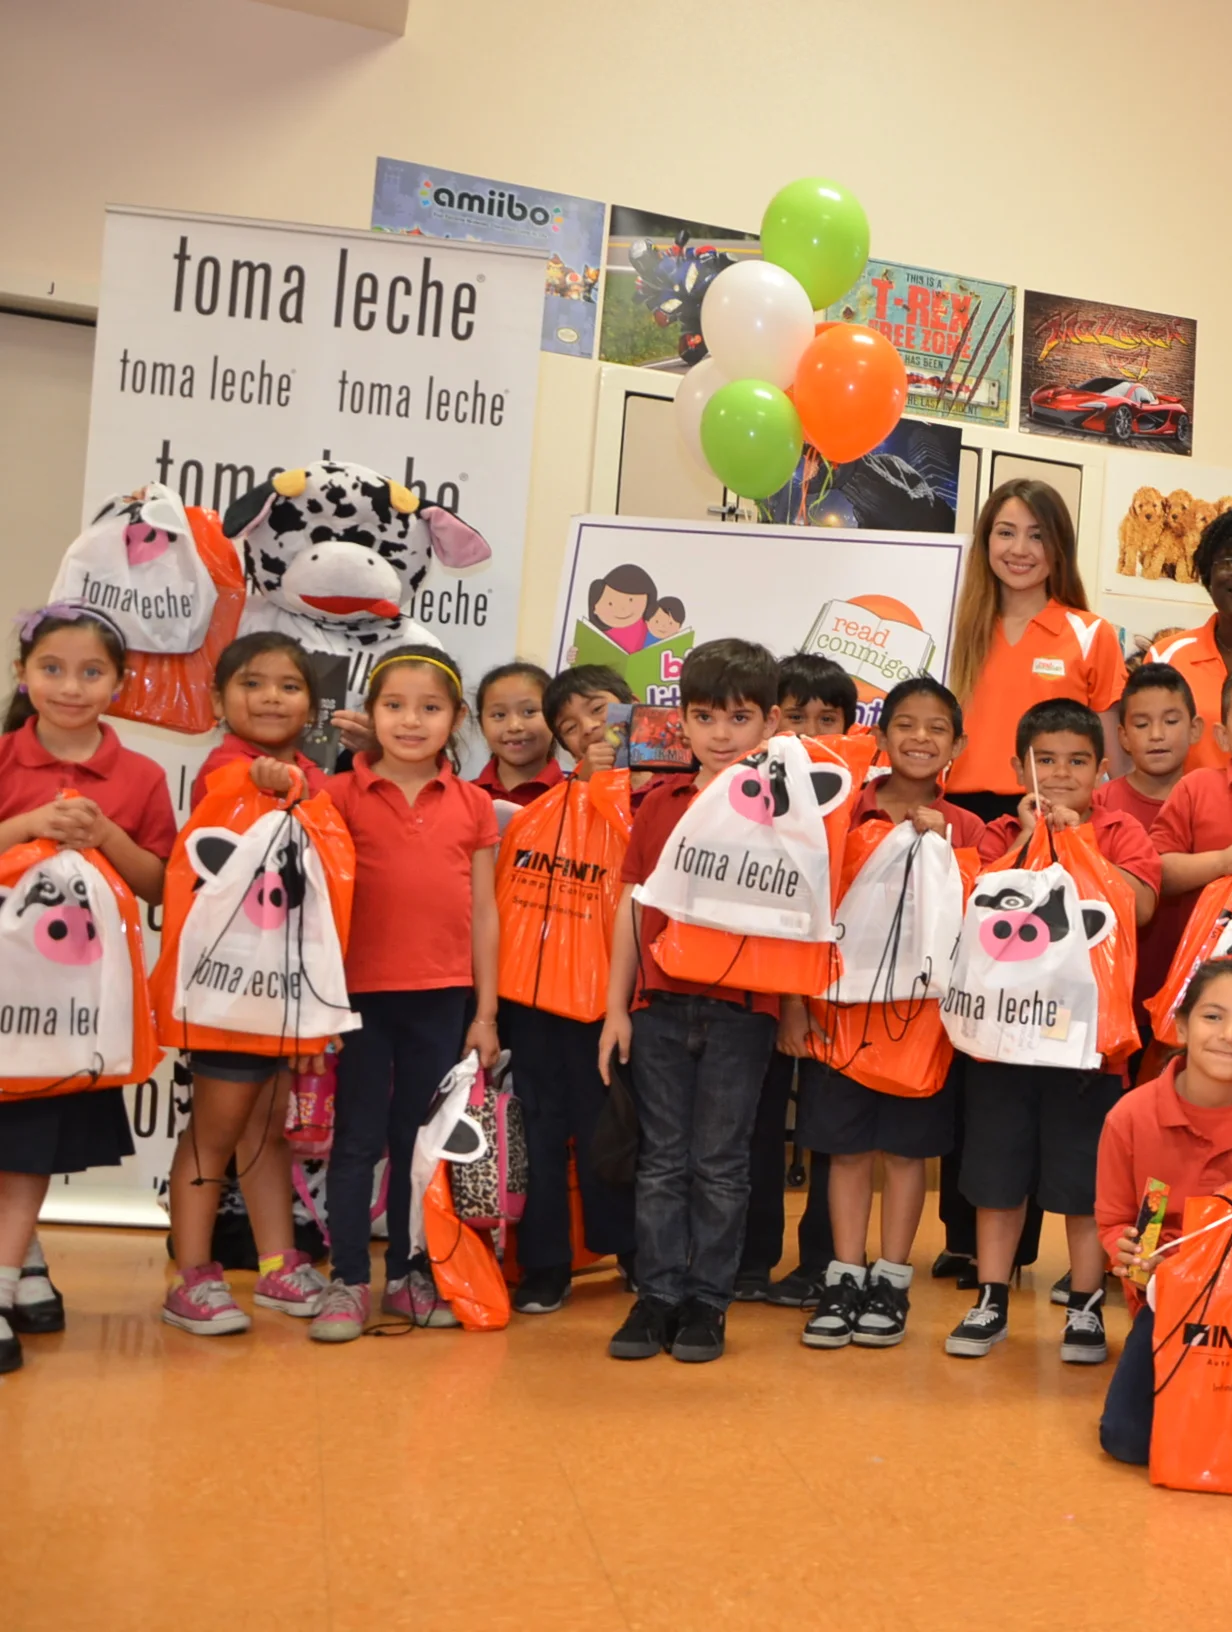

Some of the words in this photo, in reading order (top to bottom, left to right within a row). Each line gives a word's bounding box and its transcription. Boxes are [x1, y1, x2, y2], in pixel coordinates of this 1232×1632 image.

[433, 188, 550, 226] amiibo
[172, 236, 306, 324] toma
[333, 248, 477, 341] leche
[906, 273, 924, 285] THIS
[927, 276, 935, 287] IS
[936, 279, 943, 288] A
[871, 278, 973, 333] T-REX
[120, 349, 195, 398] toma
[210, 355, 292, 407] leche
[338, 370, 411, 418] toma
[425, 375, 504, 426] leche
[82, 571, 134, 612] toma
[133, 586, 192, 620] leche
[817, 633, 912, 681] conmigo
[832, 617, 890, 648] read
[674, 836, 730, 882] toma
[736, 850, 800, 898] leche
[942, 987, 986, 1021] oma
[996, 987, 1058, 1028] leche
